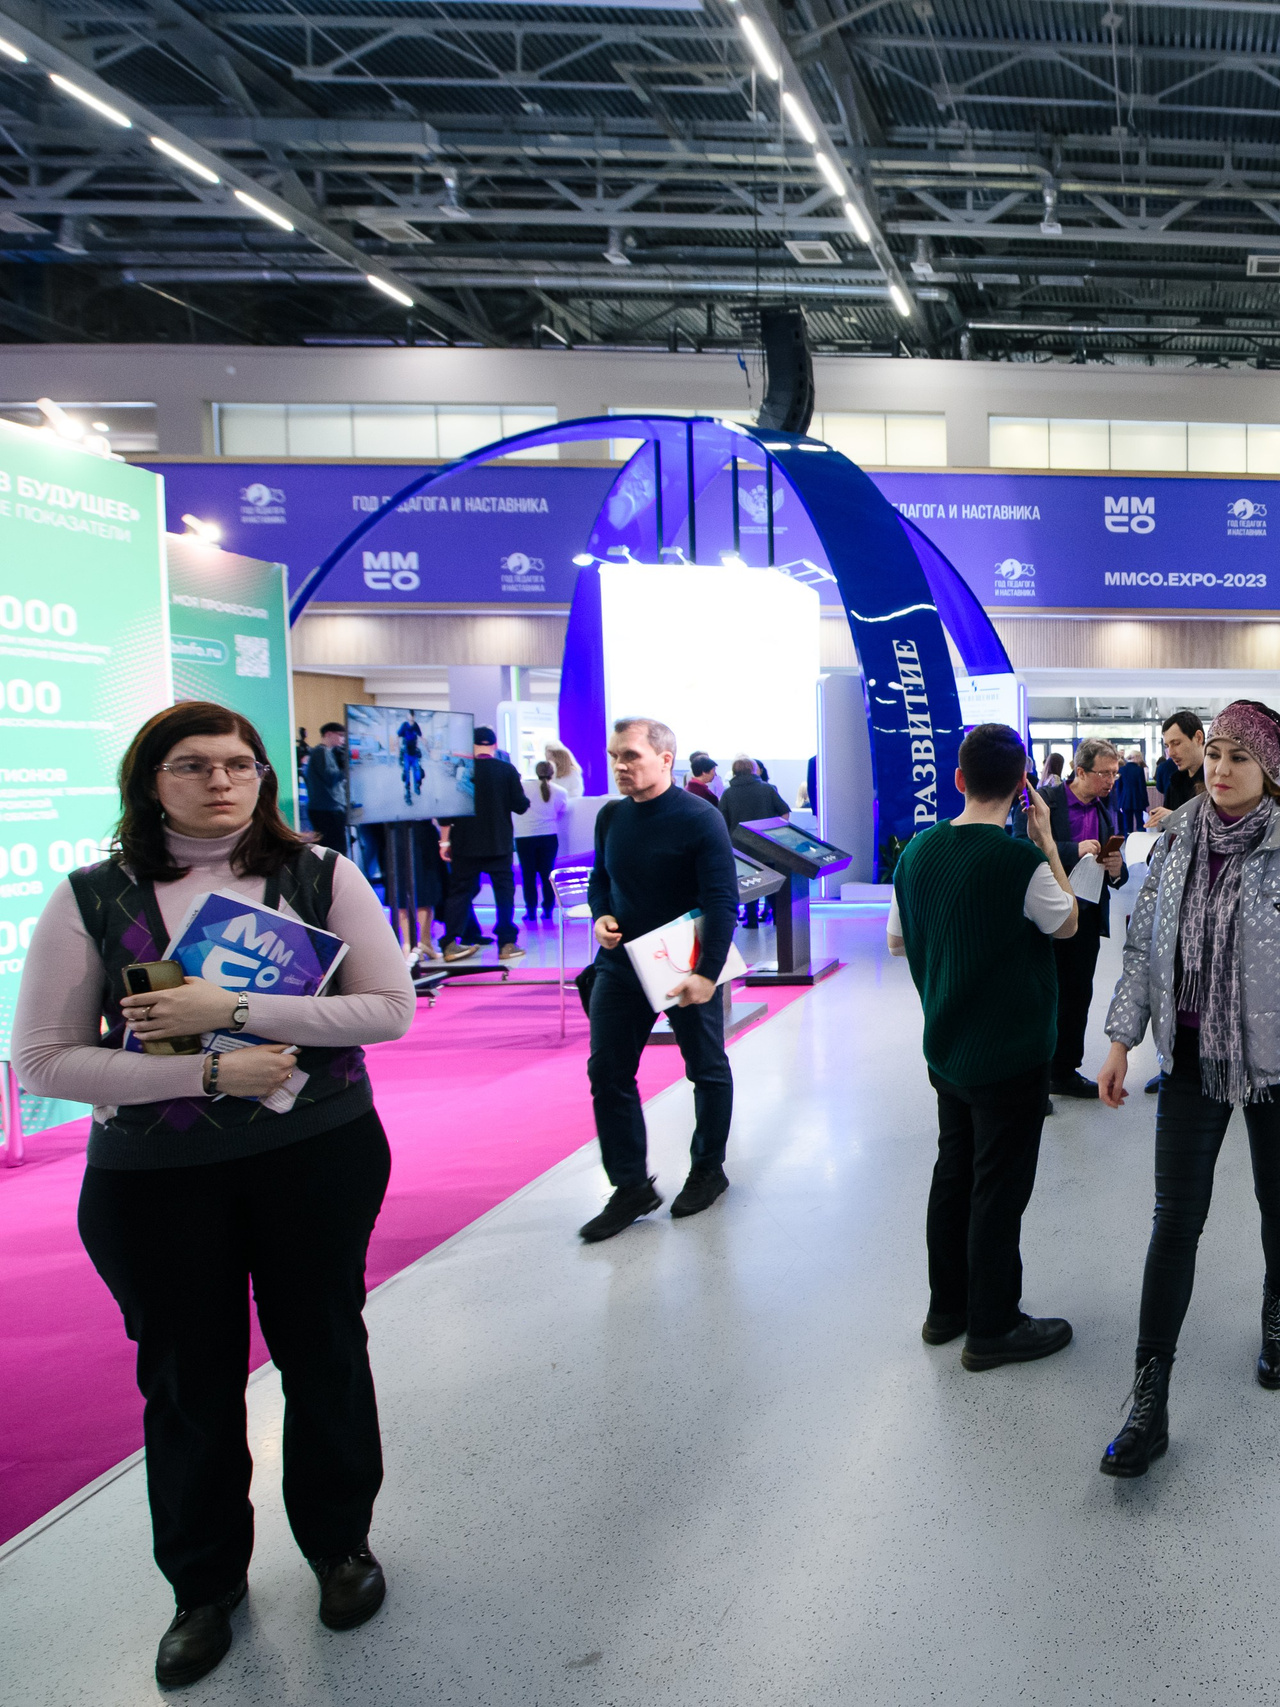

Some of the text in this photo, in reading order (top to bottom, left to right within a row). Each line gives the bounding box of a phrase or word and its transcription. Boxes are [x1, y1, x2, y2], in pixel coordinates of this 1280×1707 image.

[352, 495, 379, 513] ГОД
[451, 497, 461, 513] И
[465, 497, 549, 514] НАСТАВНИКА
[949, 504, 958, 519] И
[962, 504, 1042, 520] НАСТАВНИКА
[15, 503, 132, 543] ПОКАЗАТЕЛИ
[892, 639, 937, 825] РАЗВИТИЕ
